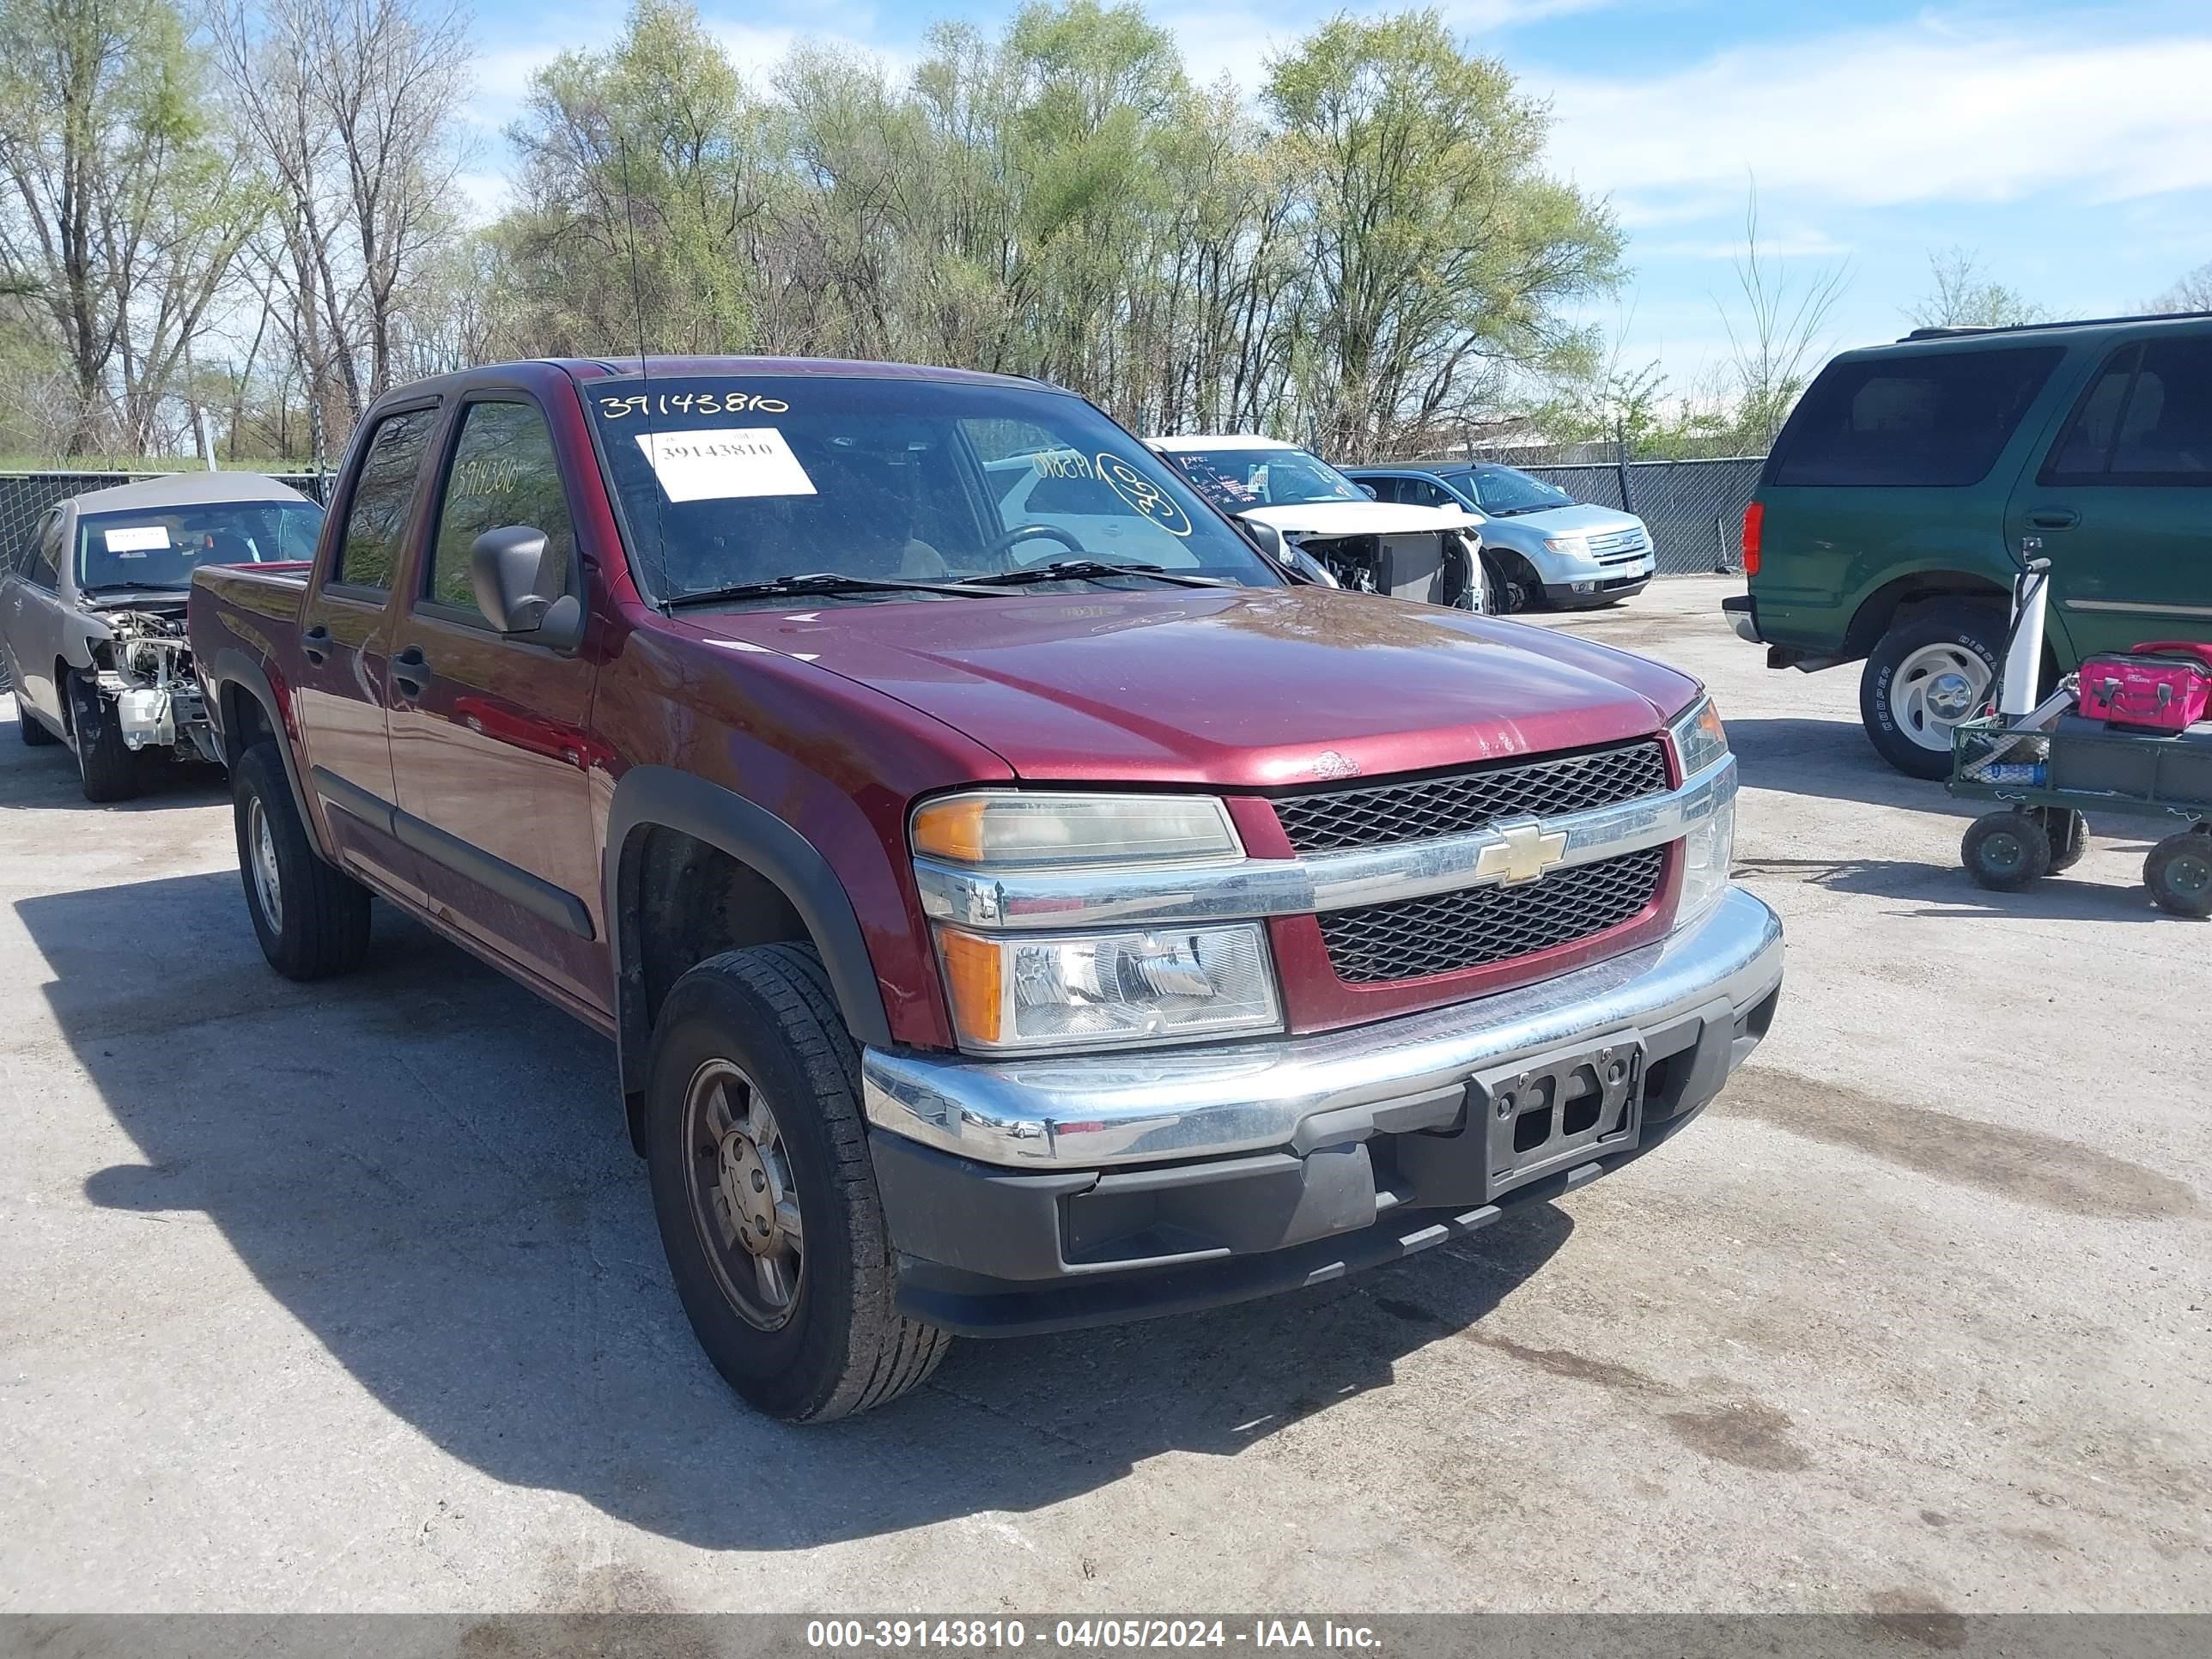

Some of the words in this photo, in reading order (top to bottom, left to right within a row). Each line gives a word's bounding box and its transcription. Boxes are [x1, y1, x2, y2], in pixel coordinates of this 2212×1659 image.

[599, 392, 789, 418] 39143810
[661, 443, 773, 460] 39143810
[453, 457, 519, 498] 39143810
[1876, 665, 1893, 731] COOPER
